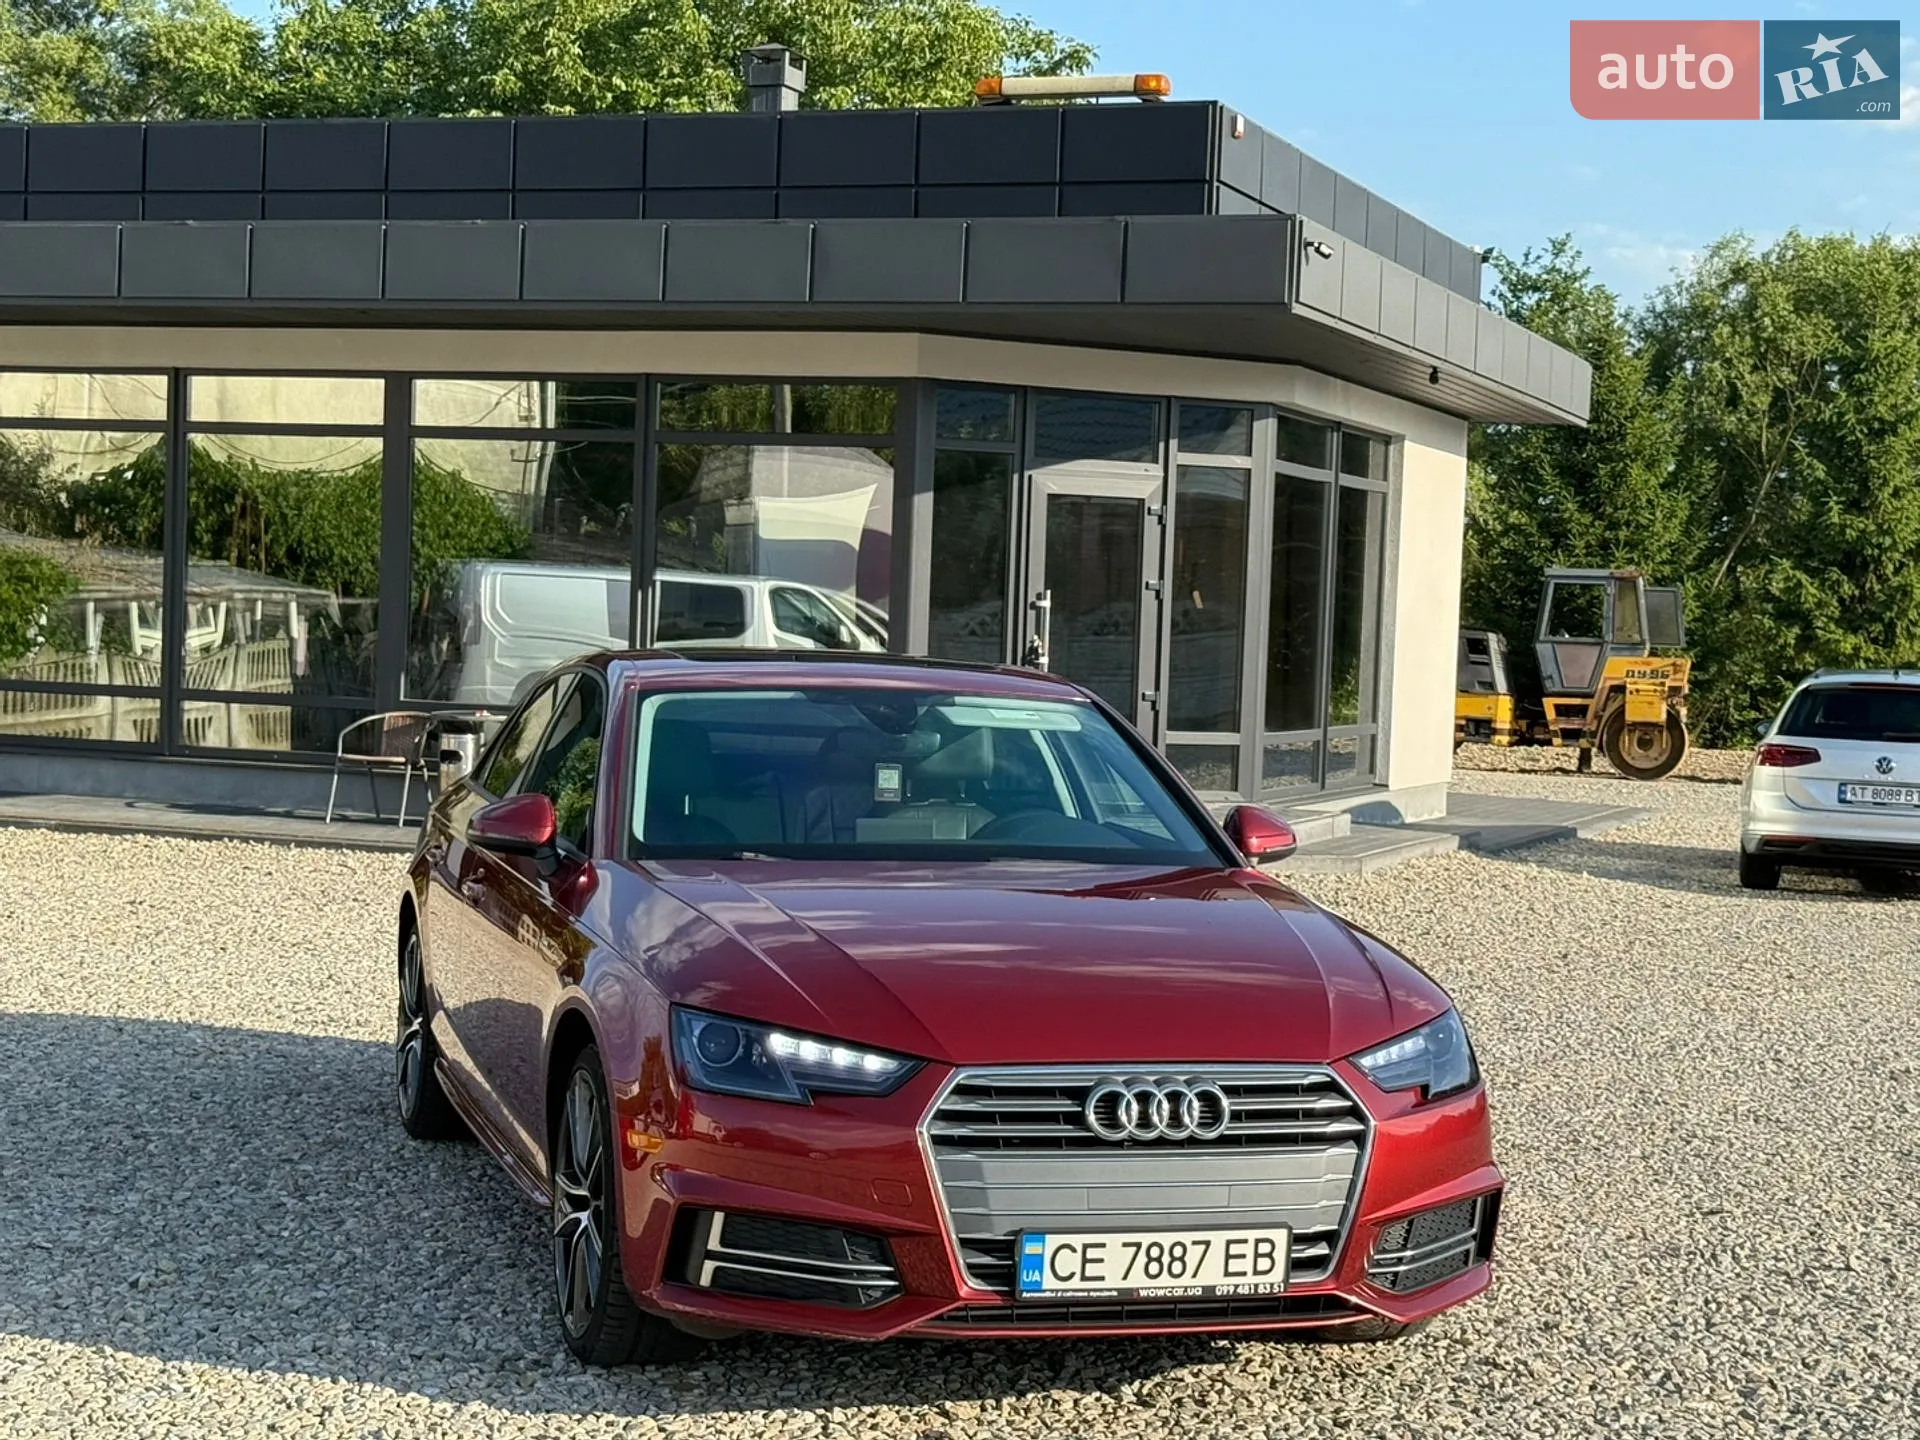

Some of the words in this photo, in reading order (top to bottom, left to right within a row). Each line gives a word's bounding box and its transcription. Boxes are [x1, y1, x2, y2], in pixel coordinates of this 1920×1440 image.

[1849, 787, 1868, 799] AT
[1050, 1242, 1107, 1282] CE
[1121, 1240, 1211, 1281] 7887
[1223, 1237, 1277, 1277] EB
[1022, 1269, 1041, 1282] UA
[1139, 1287, 1202, 1297] wowcar.ua
[1215, 1285, 1235, 1296] 099
